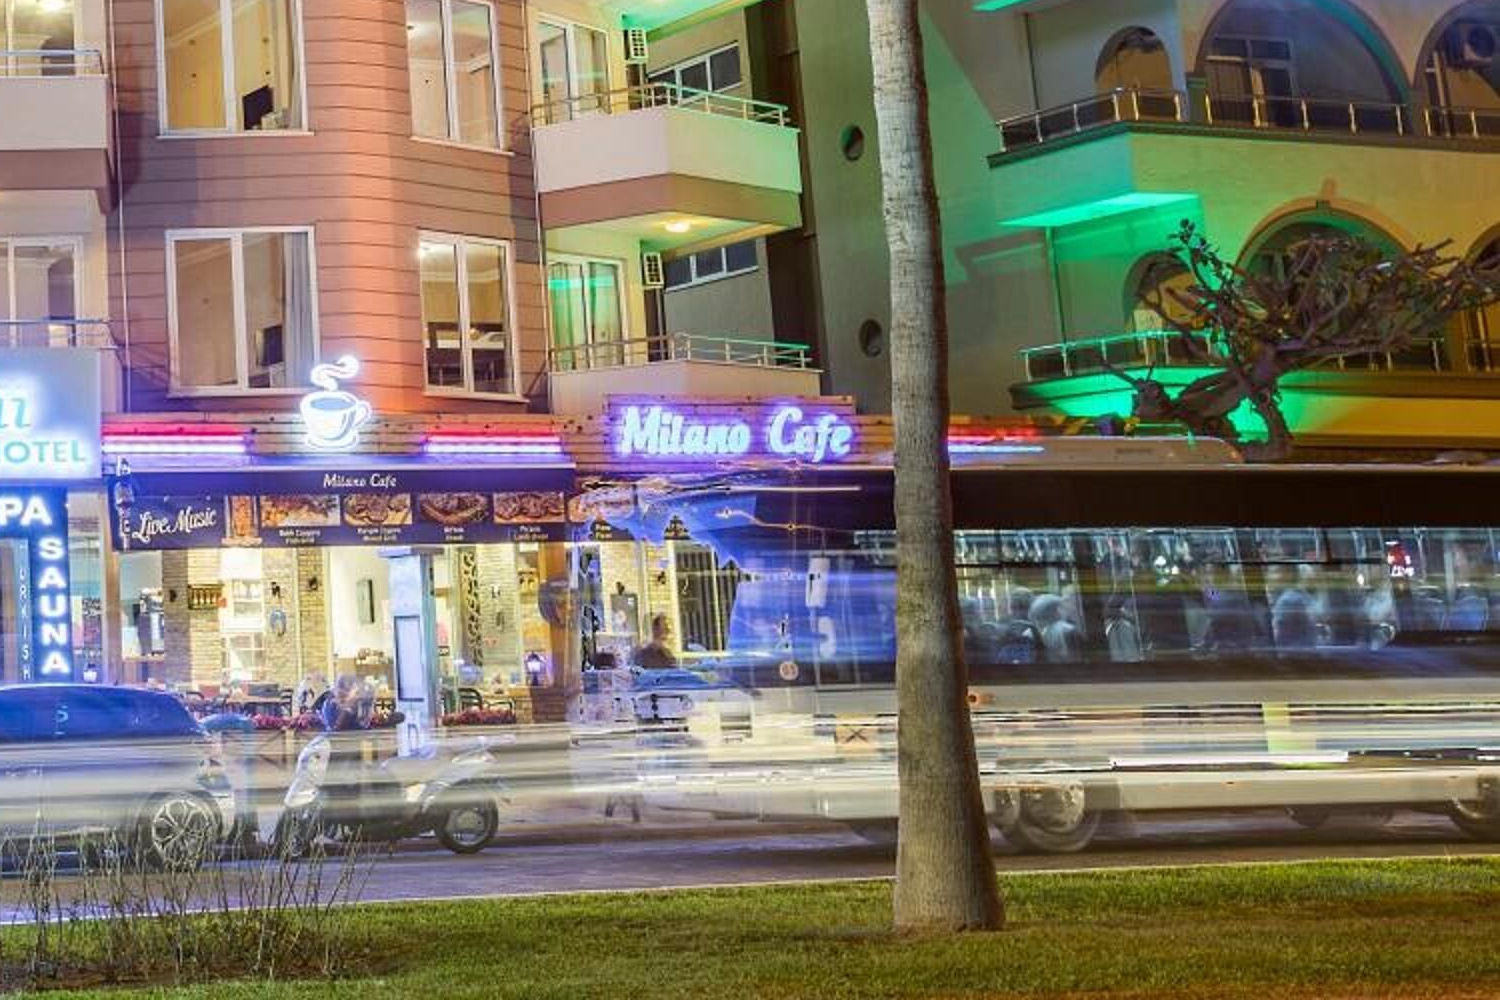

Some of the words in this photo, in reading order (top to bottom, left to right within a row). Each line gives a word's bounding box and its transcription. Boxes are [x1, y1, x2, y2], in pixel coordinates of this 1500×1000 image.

[619, 406, 750, 455] Milano
[770, 407, 852, 462] Cafe
[323, 473, 366, 488] Milano
[370, 473, 397, 489] Cafe
[132, 511, 171, 543] Live
[172, 505, 217, 534] Music
[37, 536, 71, 675] SAUNA
